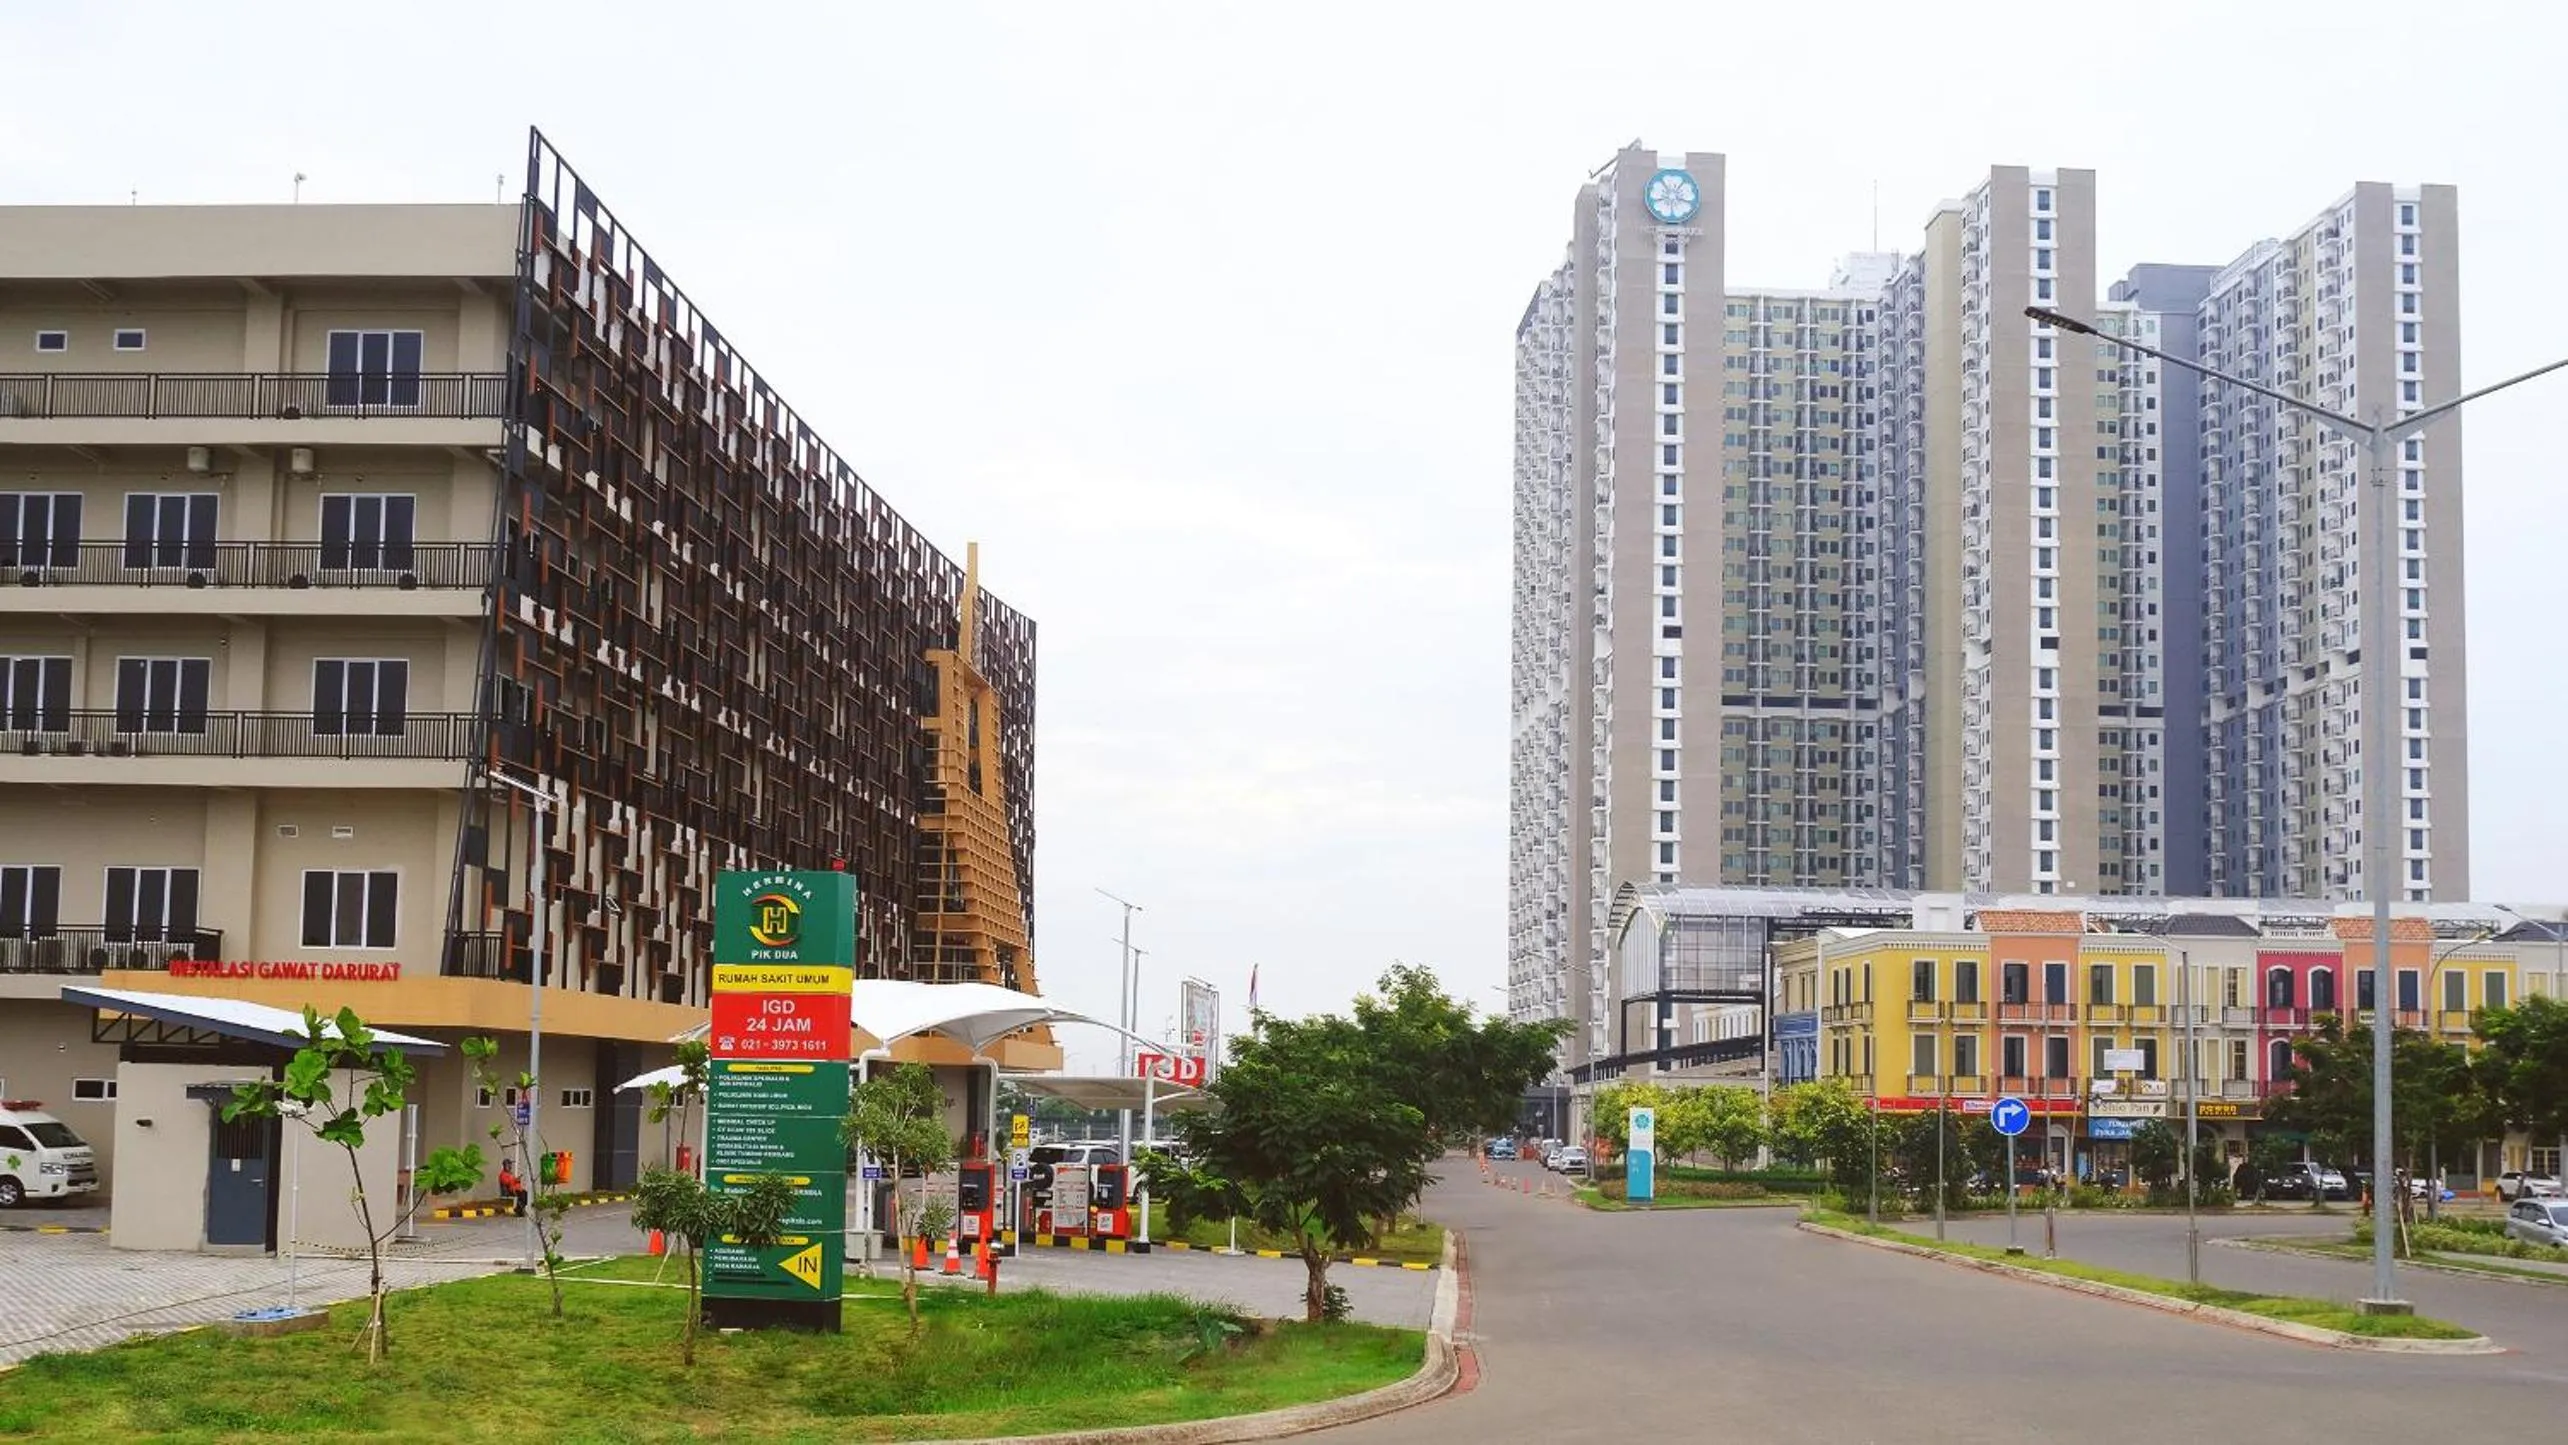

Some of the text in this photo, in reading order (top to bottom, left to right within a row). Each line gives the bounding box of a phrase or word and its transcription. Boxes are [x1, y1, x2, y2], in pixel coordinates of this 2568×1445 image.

[742, 876, 812, 900] HERMINA
[751, 949, 798, 960] PIK DUA
[257, 961, 318, 980] GAWAT
[321, 962, 402, 982] DARURAT
[718, 973, 830, 985] RUMAH SAKIT UMUM
[763, 999, 795, 1014] IGD
[746, 1017, 812, 1032] 24 JAM
[741, 1039, 761, 1051] 021
[772, 1039, 798, 1051] 3973
[798, 1256, 818, 1273] IN
